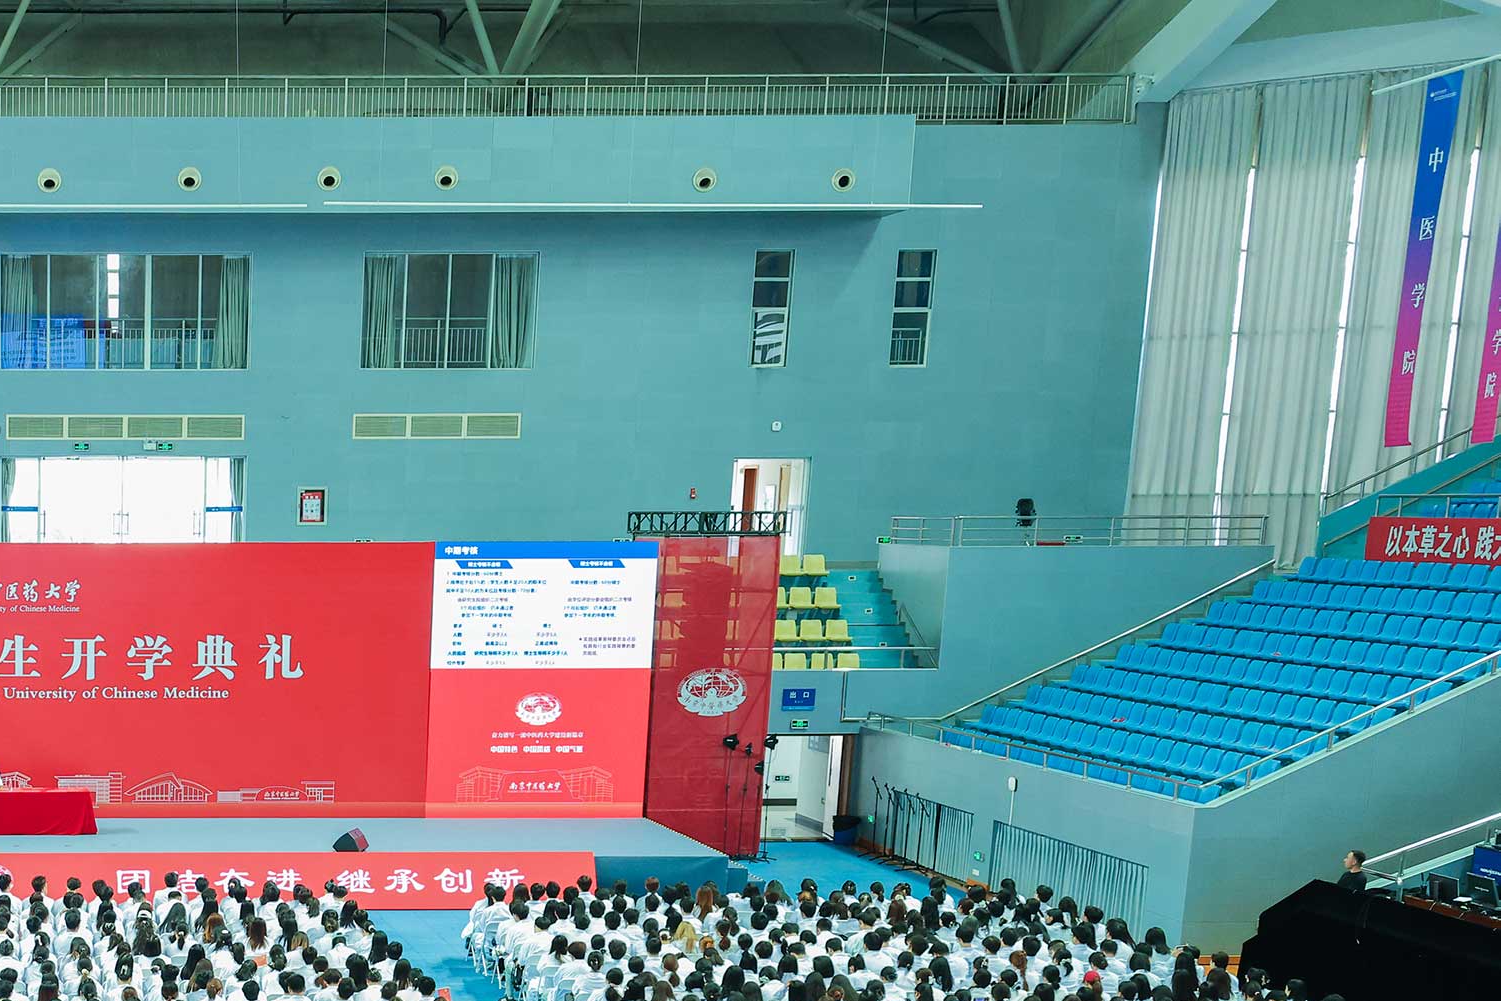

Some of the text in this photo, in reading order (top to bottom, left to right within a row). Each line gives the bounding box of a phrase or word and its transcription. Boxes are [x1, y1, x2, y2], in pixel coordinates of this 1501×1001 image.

[1401, 147, 1443, 375] 中医学院
[445, 546, 478, 555] 中期考核
[1385, 524, 1470, 559] 以本草之心
[4, 687, 76, 702] University
[83, 687, 98, 698] of
[102, 687, 157, 698] Chinese
[163, 687, 228, 698] Medicine
